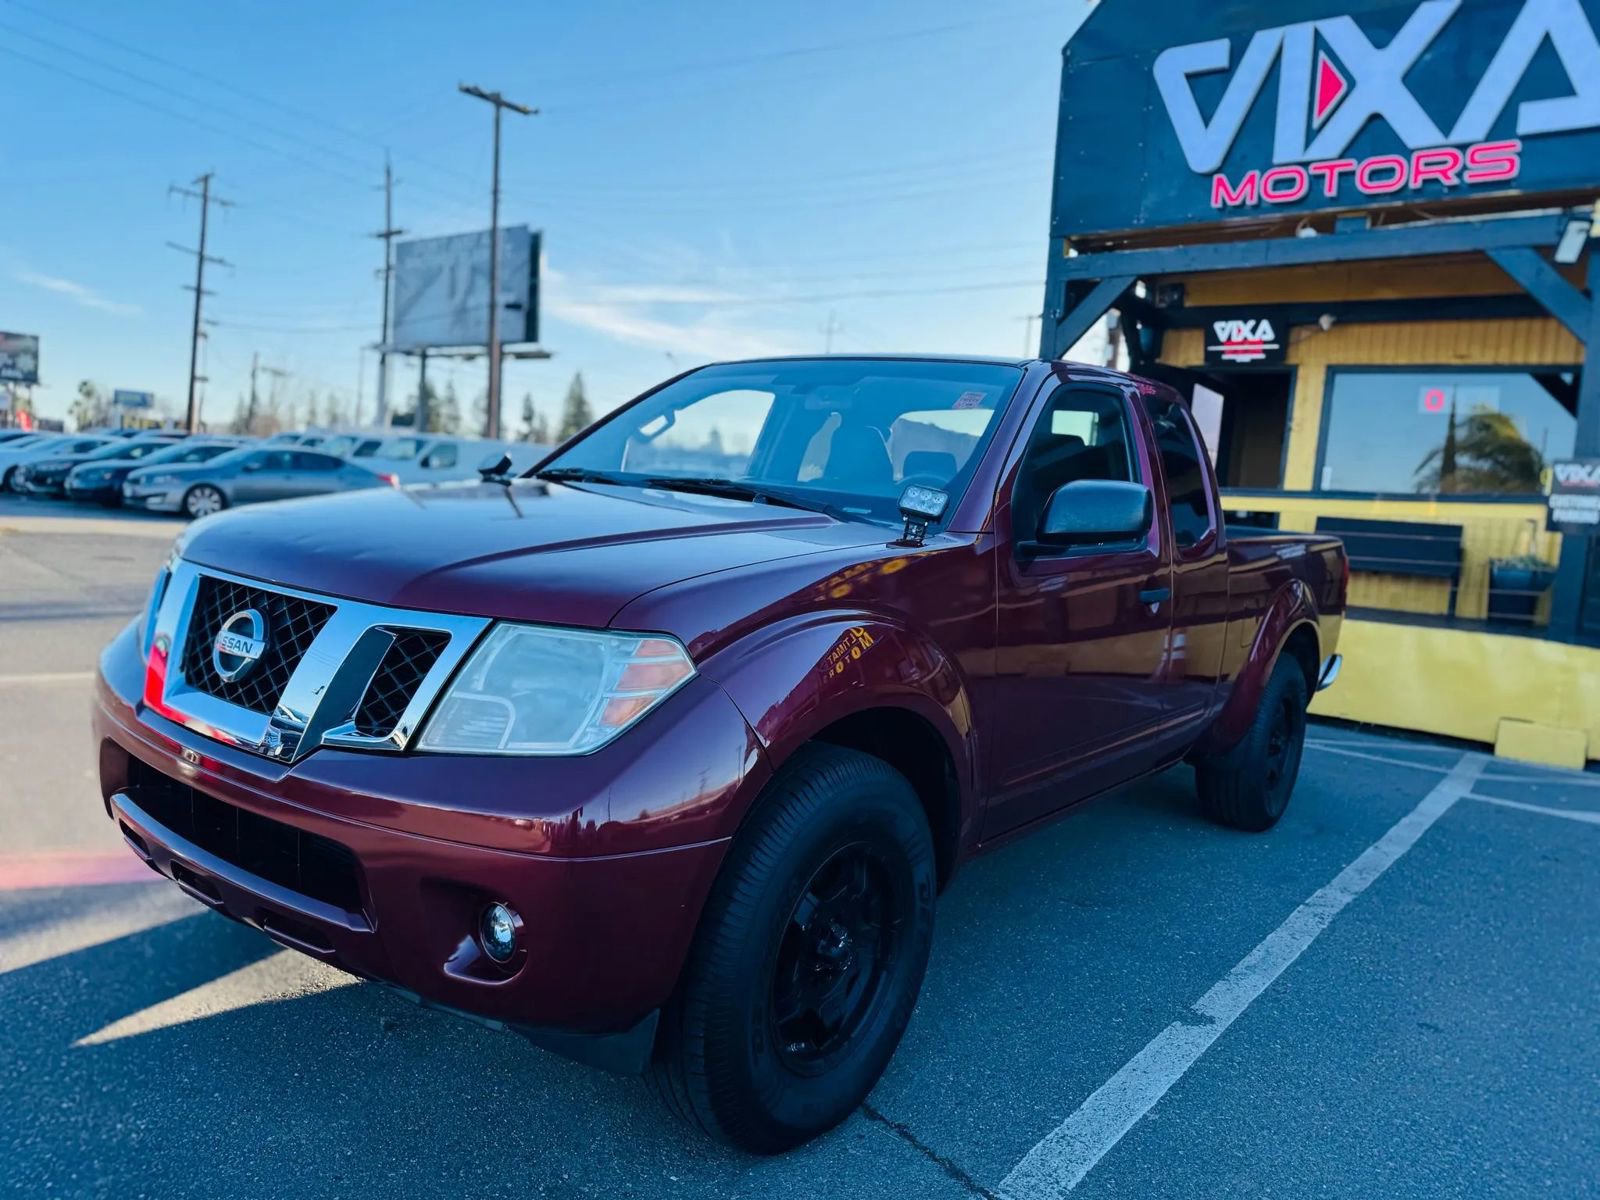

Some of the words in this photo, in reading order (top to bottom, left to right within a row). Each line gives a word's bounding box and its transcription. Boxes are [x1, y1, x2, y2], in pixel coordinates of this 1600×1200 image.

[1153, 0, 1600, 173] VIXA
[1211, 140, 1521, 207] MOTORS
[1213, 319, 1275, 342] VIXA
[216, 635, 253, 654] SSAN
